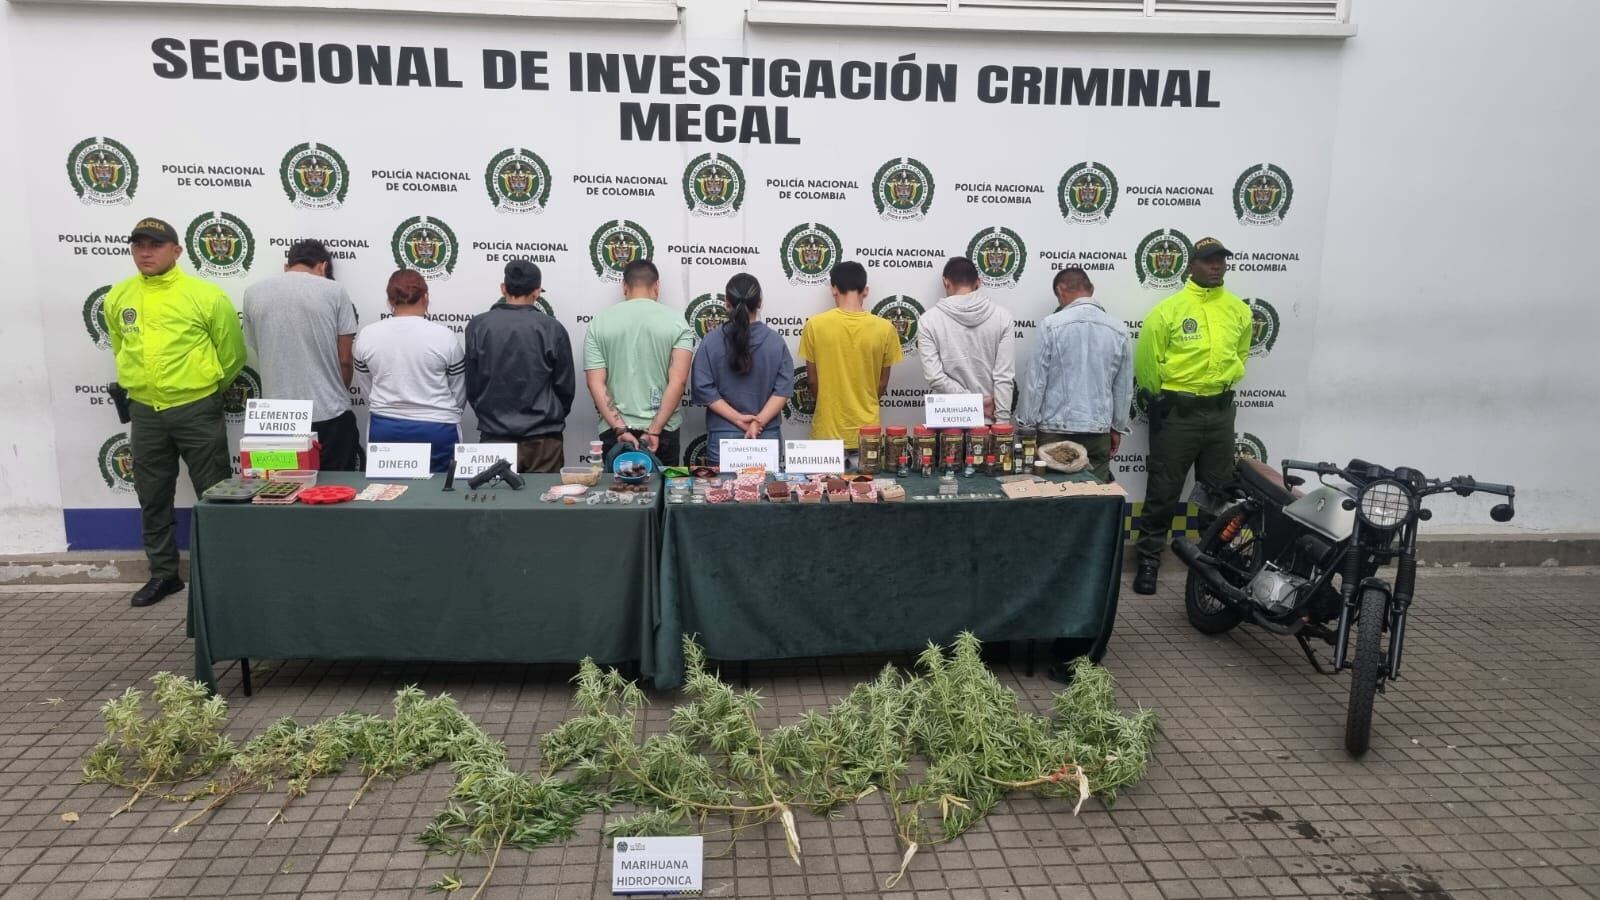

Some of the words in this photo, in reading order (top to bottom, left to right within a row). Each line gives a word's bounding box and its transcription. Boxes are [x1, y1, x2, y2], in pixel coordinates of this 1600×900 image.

[151, 37, 463, 88] SECCIONAL
[482, 49, 549, 91] DE
[568, 51, 958, 103] INVESTIGACIÓN
[977, 65, 1221, 108] CRIMINAL
[620, 102, 801, 145] MECAL
[208, 166, 265, 175] NACIONAL
[416, 171, 470, 180] NACIONAL
[178, 178, 191, 186] DE
[195, 178, 252, 187] COLOMBIA
[616, 176, 668, 185] NACIONAL
[808, 180, 859, 188] NACIONAL
[386, 183, 399, 191] DE
[402, 183, 457, 192] COLOMBIA
[586, 187, 599, 195] DE
[602, 188, 655, 196] COLOMBIA
[1166, 187, 1214, 195] NACIONAL
[779, 191, 791, 199] DE
[795, 191, 846, 200] COLOMBIA
[967, 195, 978, 203] DE
[982, 196, 1031, 204] COLOMBIA
[1152, 198, 1201, 206] COLOMBIA
[74, 247, 88, 255] DE
[91, 247, 131, 256] COLOM
[516, 243, 568, 251] NACIONAL
[709, 246, 760, 254] NACIONAL
[896, 249, 945, 257] NACIONAL
[1252, 253, 1300, 261] NACIONAL
[503, 254, 555, 263] COLOMBIA
[696, 257, 747, 265] COLOMBIA
[883, 260, 933, 268] COLOMBIA
[1066, 263, 1115, 272] COLOMBIA
[1239, 264, 1287, 272] COLOMBIA
[75, 384, 109, 393] POLICÍ
[90, 397, 104, 405] DE
[934, 406, 979, 414] MARIHUANA
[249, 411, 309, 421] ELEMENTOS
[259, 422, 296, 431] VARIOS
[378, 459, 418, 469] DINERO
[470, 455, 500, 464] ARMA
[788, 456, 841, 465] MARIHUANA
[460, 466, 473, 475] DE
[1119, 465, 1130, 473] DE
[621, 860, 689, 870] MARIHUANA
[617, 876, 692, 886] HIDROPONICA
